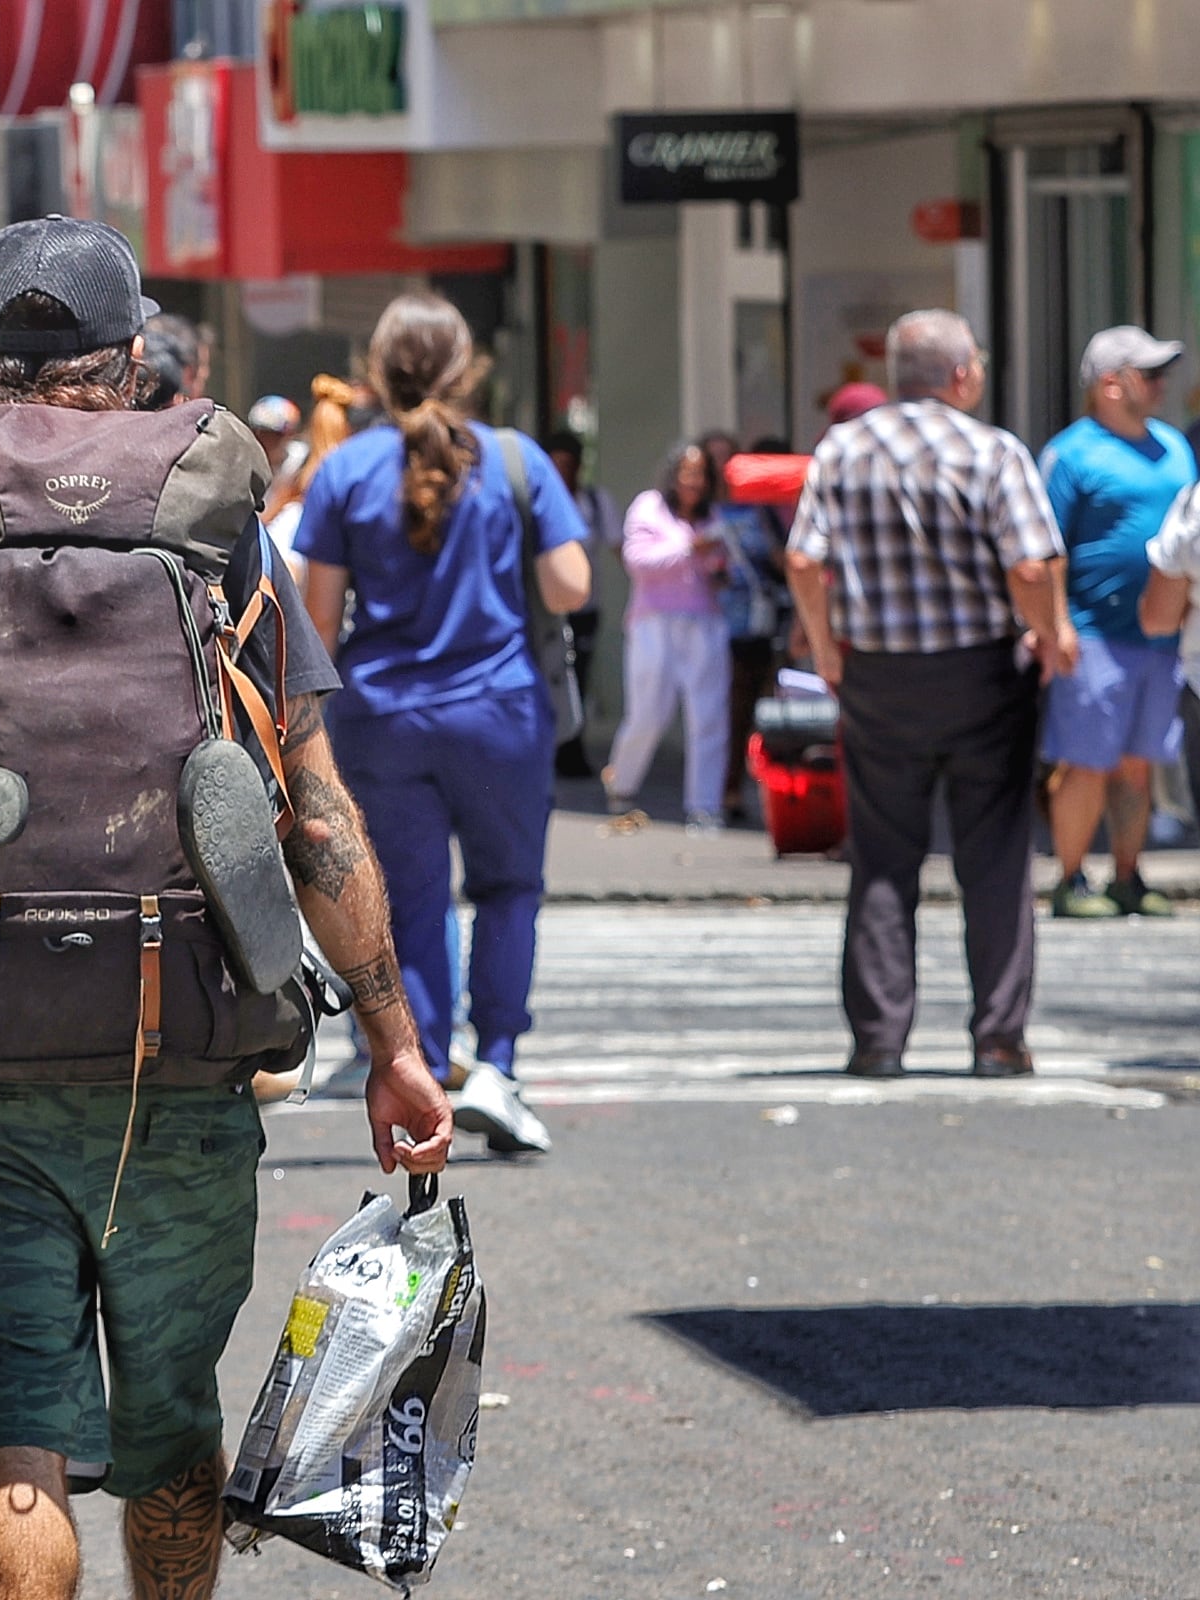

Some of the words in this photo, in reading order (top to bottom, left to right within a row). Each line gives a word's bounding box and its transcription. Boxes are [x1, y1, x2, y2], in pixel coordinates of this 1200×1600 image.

[45, 474, 112, 491] OSPREY
[24, 908, 78, 921] ROOK
[83, 908, 110, 921] 50
[397, 1497, 414, 1520] 10
